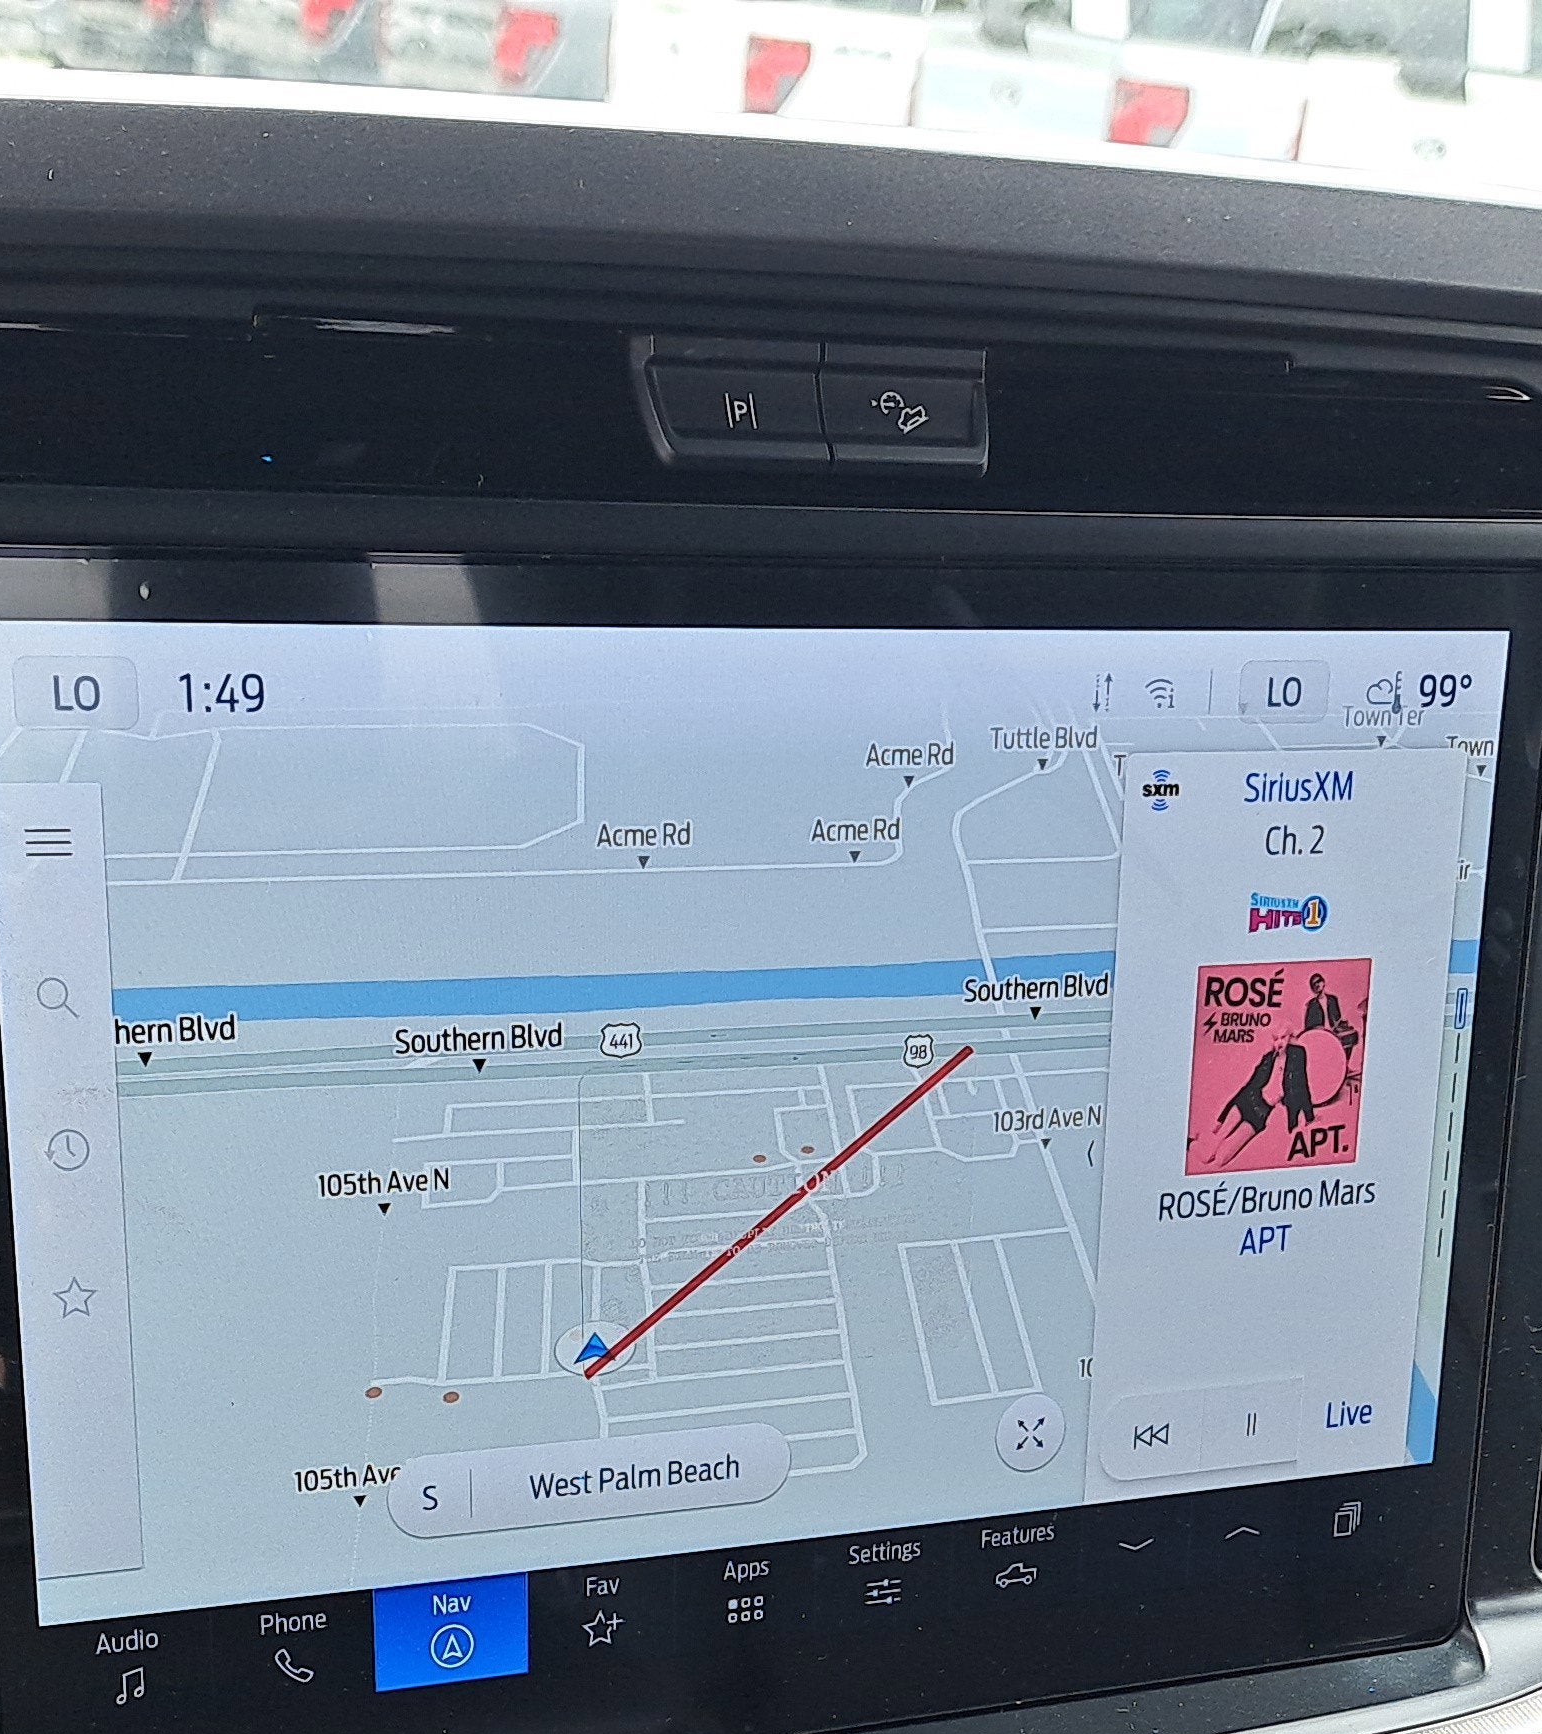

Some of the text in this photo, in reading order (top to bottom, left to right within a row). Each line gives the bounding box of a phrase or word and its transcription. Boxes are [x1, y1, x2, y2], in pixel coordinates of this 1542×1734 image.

[52, 674, 101, 712] LO
[177, 672, 266, 714] 1:49
[1266, 676, 1303, 707] LO
[1419, 673, 1473, 708] 99°
[1343, 705, 1391, 727] Town
[991, 725, 1098, 749] Tuttle Blvd
[865, 742, 955, 768] Acme Rd
[1244, 771, 1354, 804] SiriusXM
[596, 821, 692, 848] Acme Rd
[811, 817, 901, 844] Acme Rd
[1265, 824, 1326, 856] Ch. 2
[964, 973, 1110, 1003] Southern Blvd
[1204, 968, 1285, 1008] ROSÉ
[179, 1013, 236, 1042] Blvd
[1221, 1012, 1272, 1028] BRUNO
[395, 1023, 563, 1055] Southern Blvd
[610, 1033, 633, 1050] 441
[1213, 1029, 1255, 1044] MARS
[909, 1043, 928, 1061] 98
[992, 1105, 1102, 1133] 103rd Ave N
[1287, 1124, 1349, 1161] APT.
[318, 1167, 451, 1198] 105th Ave N
[1158, 1178, 1376, 1222] ROSÉ/Bruno Mars
[1238, 1224, 1292, 1256] APT
[1325, 1401, 1373, 1430] Live
[293, 1466, 358, 1493] 105th
[529, 1452, 740, 1500] West Palm Beach
[422, 1485, 439, 1511] S
[980, 1523, 1056, 1549] Features
[848, 1539, 922, 1567] Settings
[723, 1560, 771, 1583] Apps
[585, 1576, 620, 1597] Fav
[431, 1594, 472, 1615] Nav
[260, 1610, 328, 1636] Phone
[95, 1630, 160, 1656] Audio
